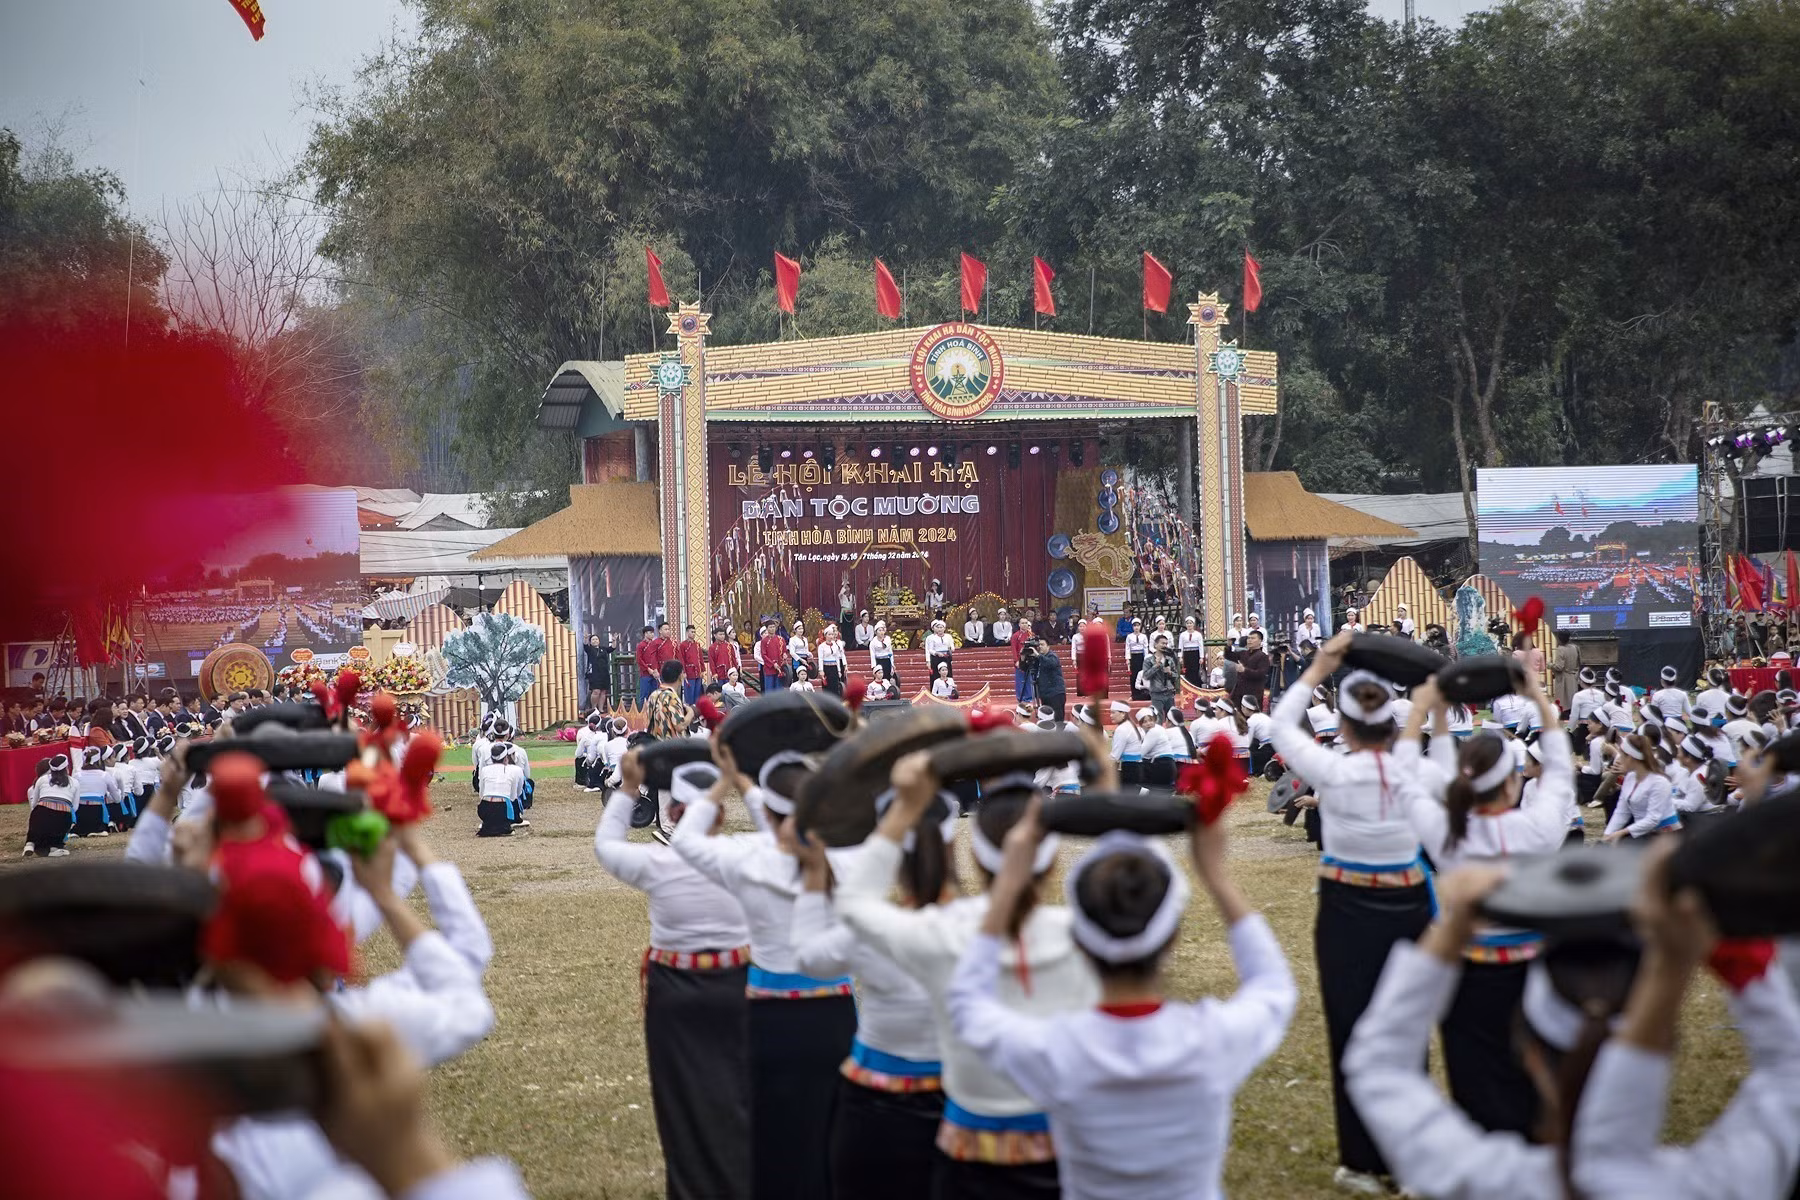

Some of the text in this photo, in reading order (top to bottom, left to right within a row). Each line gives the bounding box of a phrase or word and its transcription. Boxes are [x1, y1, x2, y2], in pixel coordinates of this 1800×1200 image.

[942, 325, 955, 336] HẠ
[956, 324, 975, 336] DÂN
[975, 330, 990, 346] TỘC
[923, 330, 942, 349] KHAI
[915, 347, 928, 363] HỘI
[913, 364, 923, 376] LỄ
[946, 406, 964, 417] BÌNH
[978, 392, 994, 409] 2024
[772, 458, 832, 493] HỘI
[841, 462, 923, 485] KHAI
[930, 461, 979, 489] HẠ
[810, 494, 868, 520] TỘC
[873, 493, 980, 516] MƯỜNG
[801, 524, 833, 546] HÒA
[836, 524, 874, 545] BÌNH
[877, 524, 914, 544] NĂM
[918, 527, 957, 544] 2024
